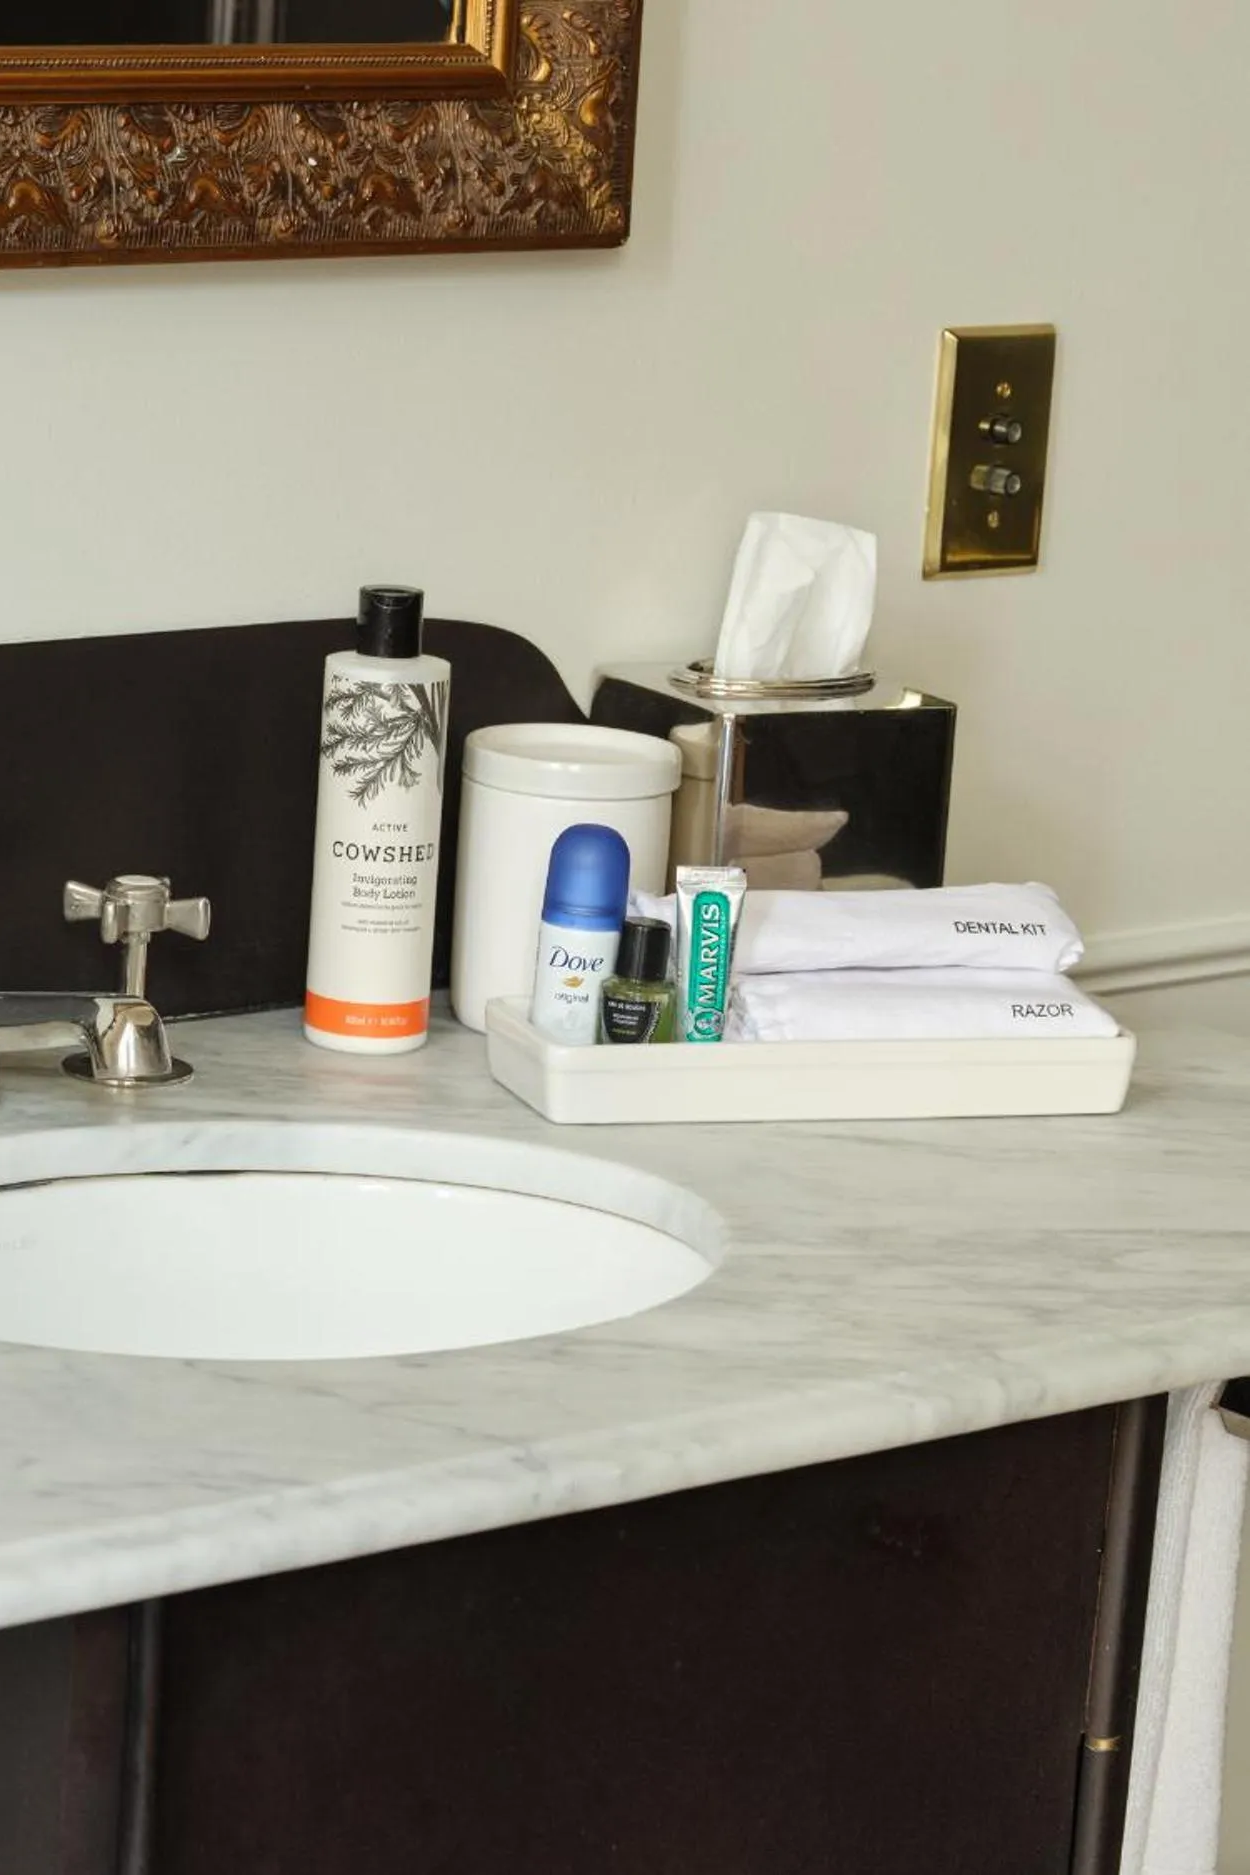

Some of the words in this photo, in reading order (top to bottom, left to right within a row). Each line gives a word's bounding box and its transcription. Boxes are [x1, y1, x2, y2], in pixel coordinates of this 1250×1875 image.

[371, 823, 409, 833] ACTIVE
[332, 841, 435, 863] COWSHED
[352, 873, 418, 887] Invigorating
[352, 886, 381, 901] Body
[383, 887, 416, 900] Lotion
[953, 920, 1019, 936] DENTAL
[1021, 923, 1047, 936] KIT
[549, 946, 604, 972] Dove
[698, 903, 721, 1006] MARVIS
[1011, 1003, 1074, 1019] RAZOR
